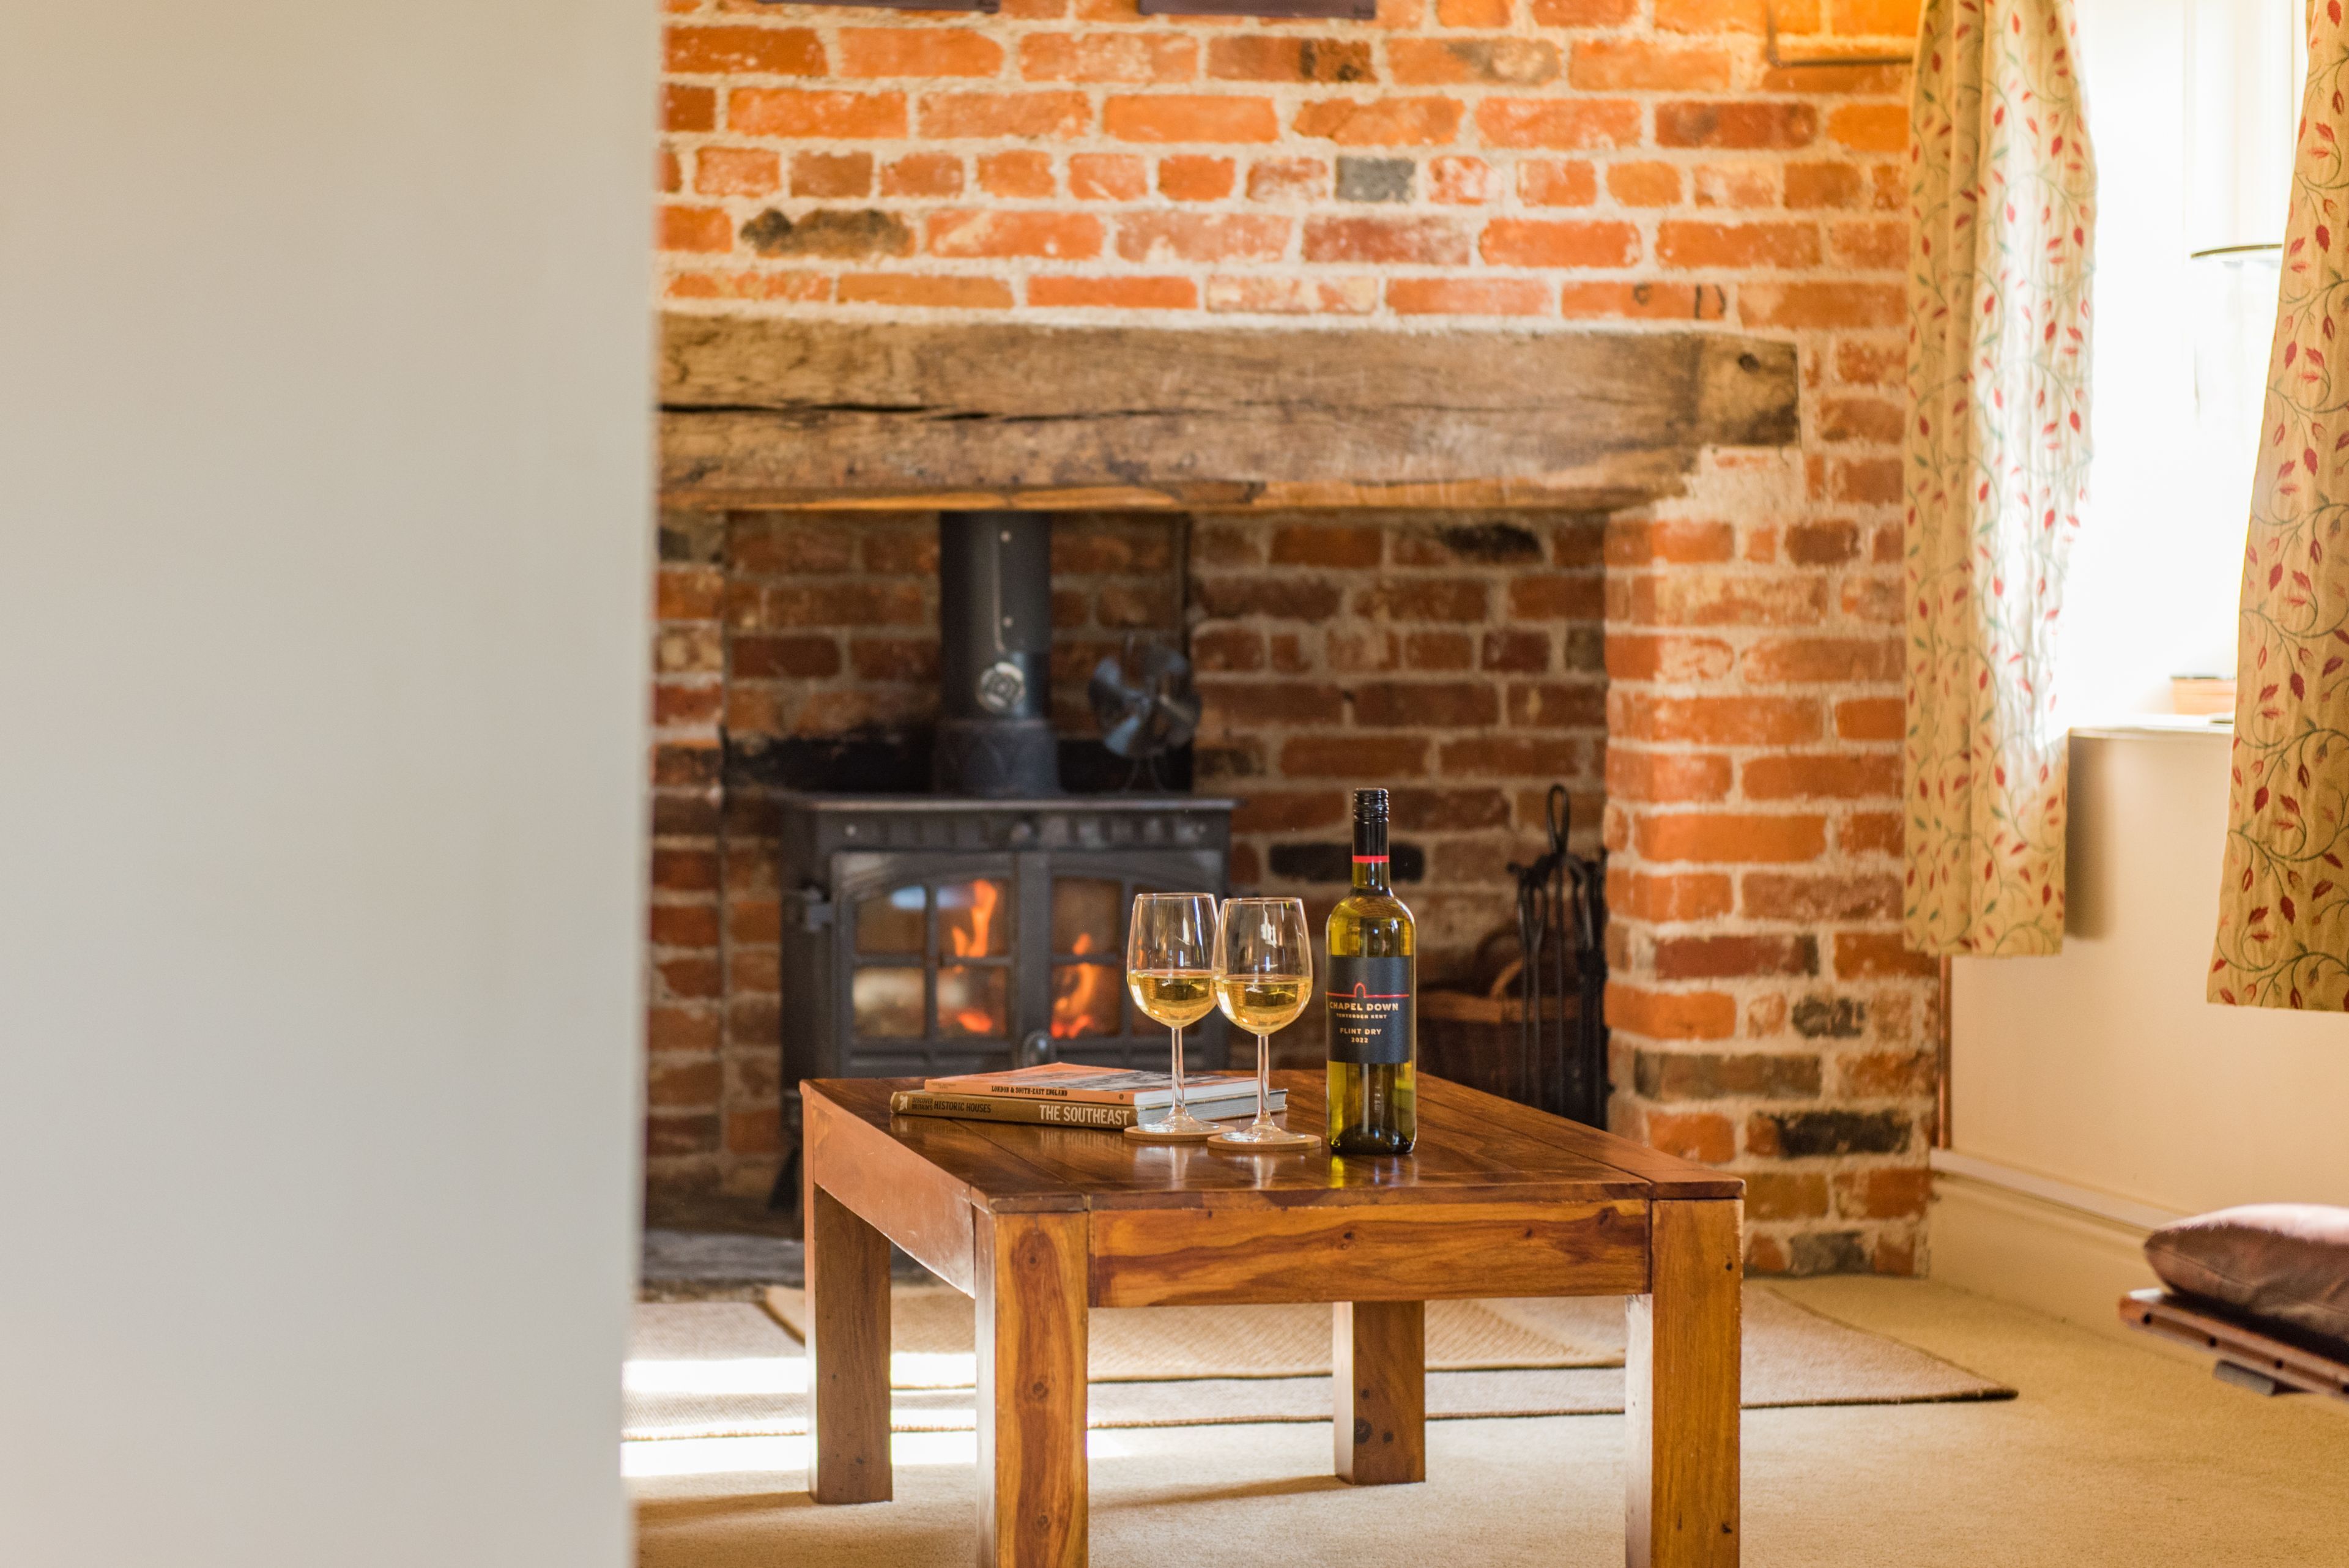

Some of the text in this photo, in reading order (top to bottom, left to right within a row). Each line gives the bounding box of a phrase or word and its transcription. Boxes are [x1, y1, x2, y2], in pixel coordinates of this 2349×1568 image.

[1329, 1001, 1363, 1011] CHAPEL
[934, 1101, 991, 1113] HISTORIC HOUSES
[1039, 1104, 1130, 1125] THE SOUTHEAST
